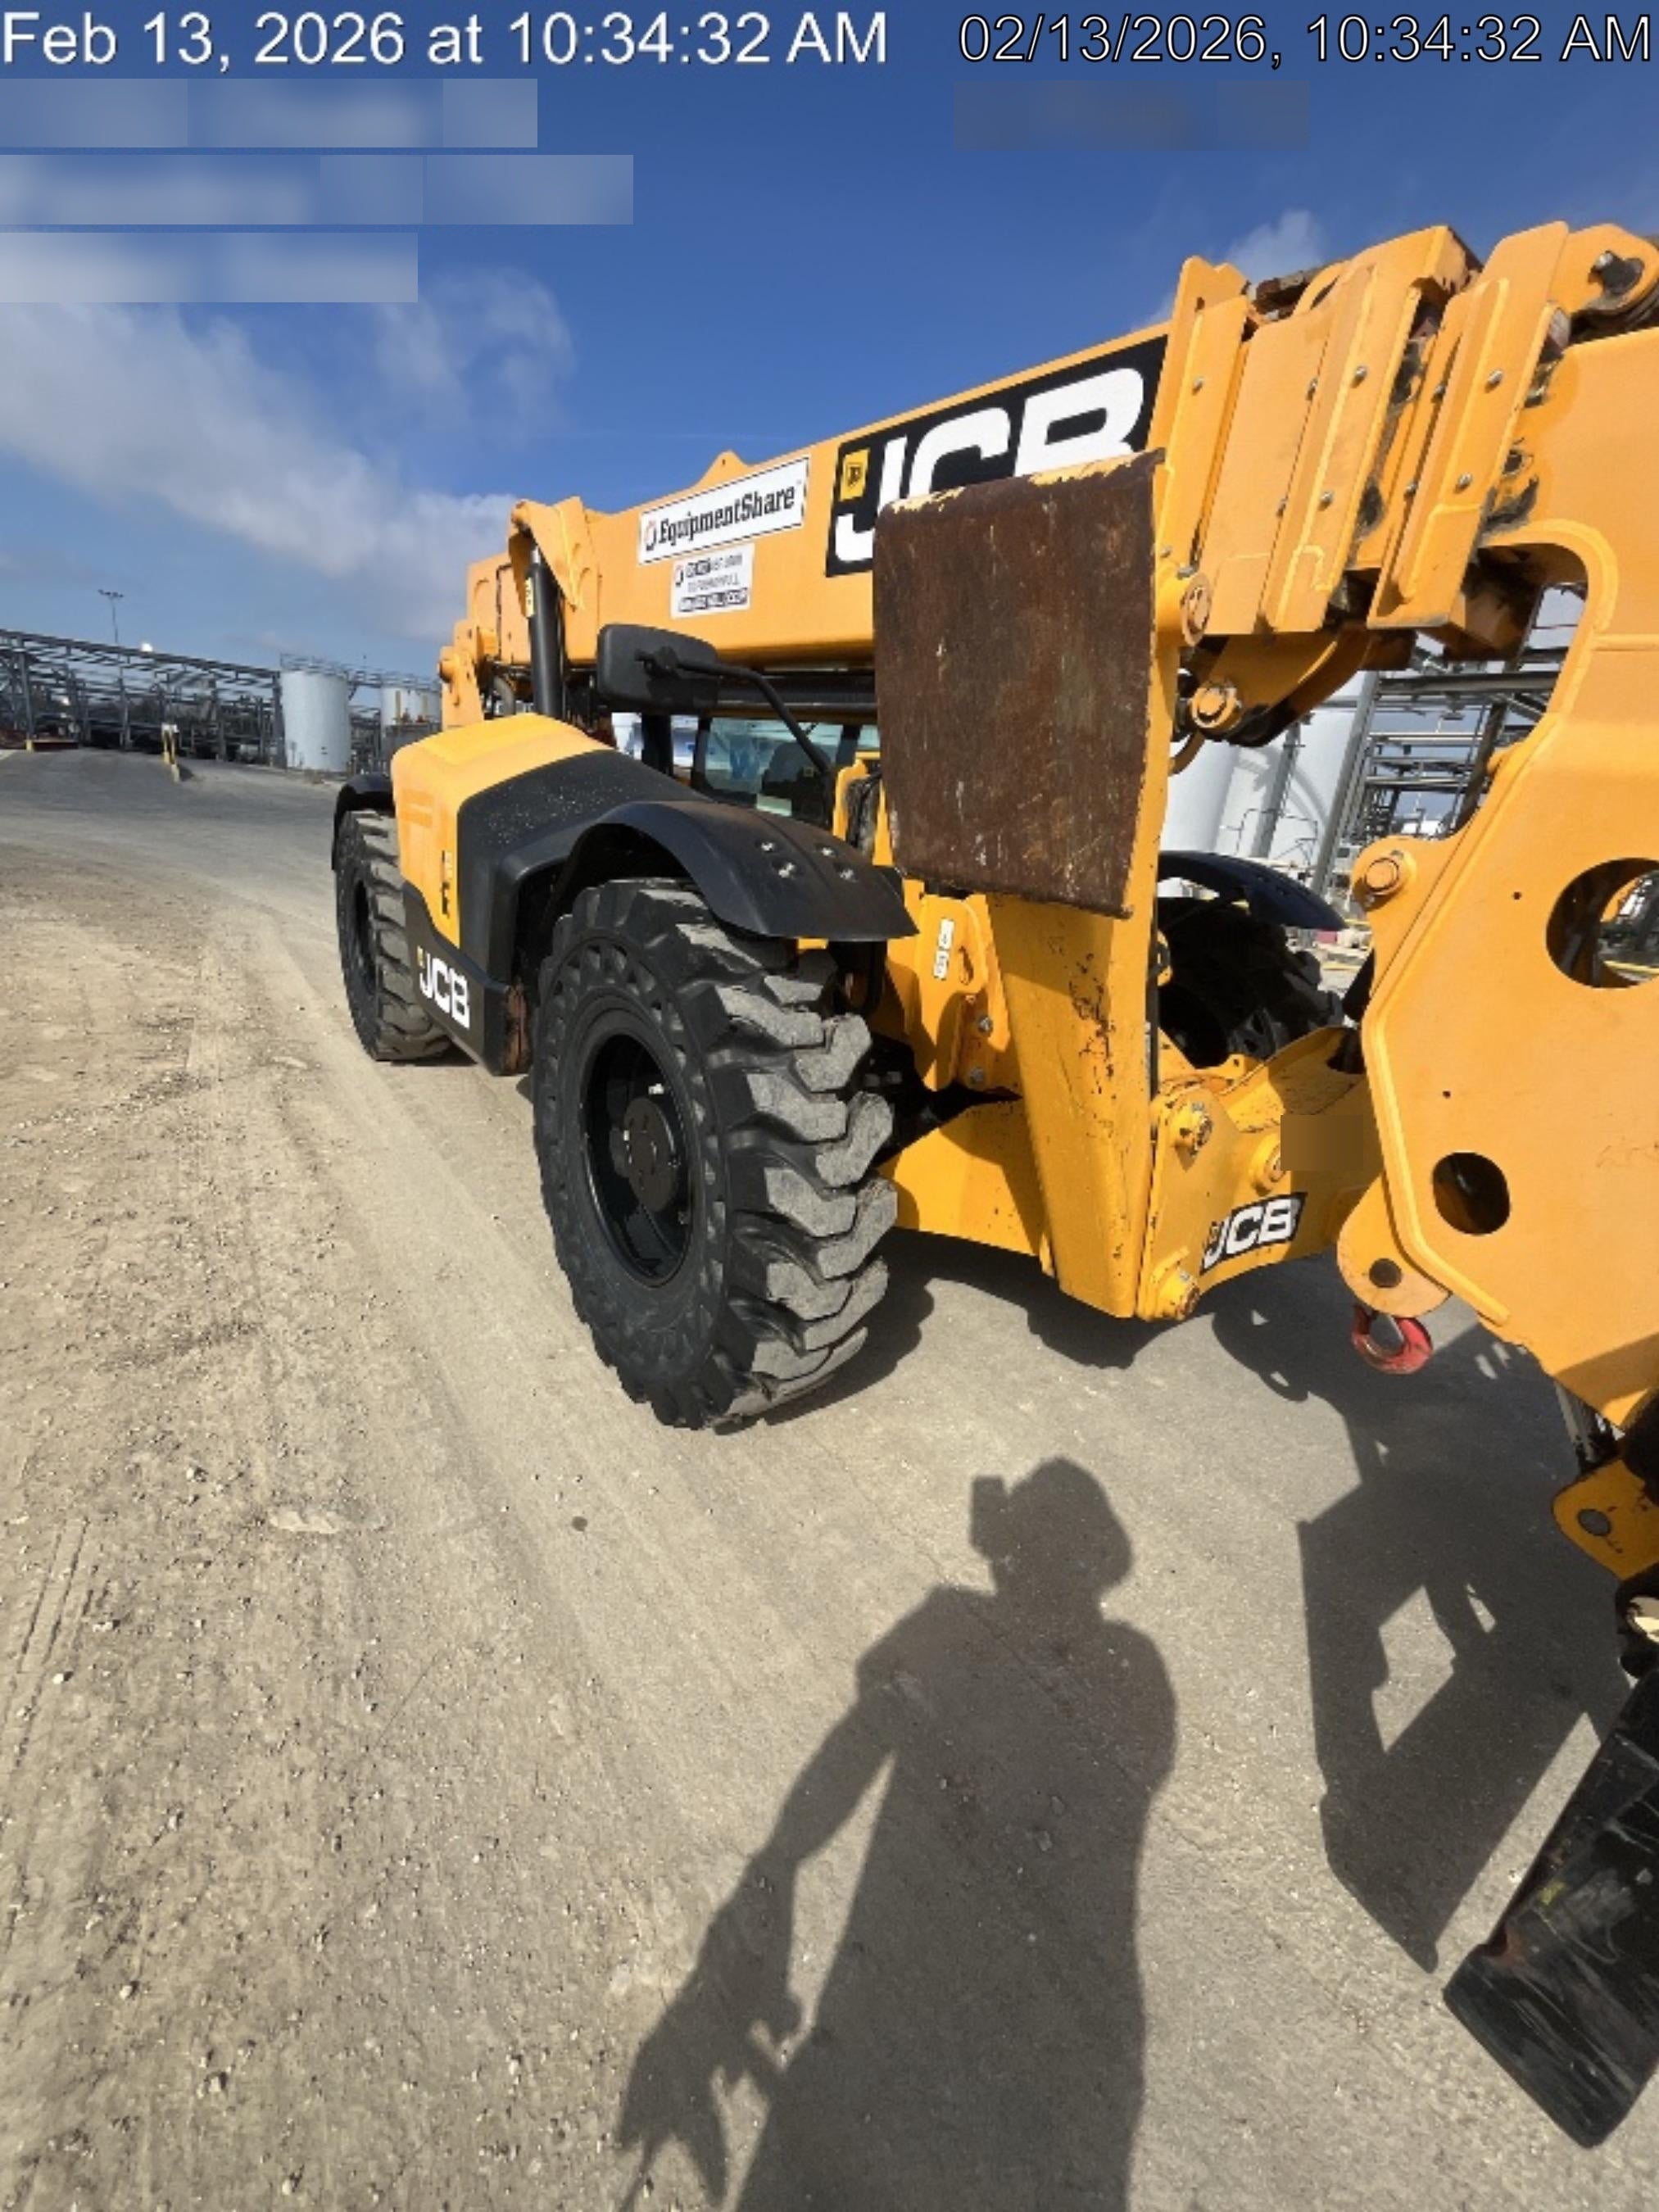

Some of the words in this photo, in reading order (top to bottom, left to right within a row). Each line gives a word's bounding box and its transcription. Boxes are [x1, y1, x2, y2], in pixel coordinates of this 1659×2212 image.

[658, 485, 796, 546] EquipmentShare
[419, 950, 471, 1029] JCB
[1203, 1198, 1301, 1270] JCB
